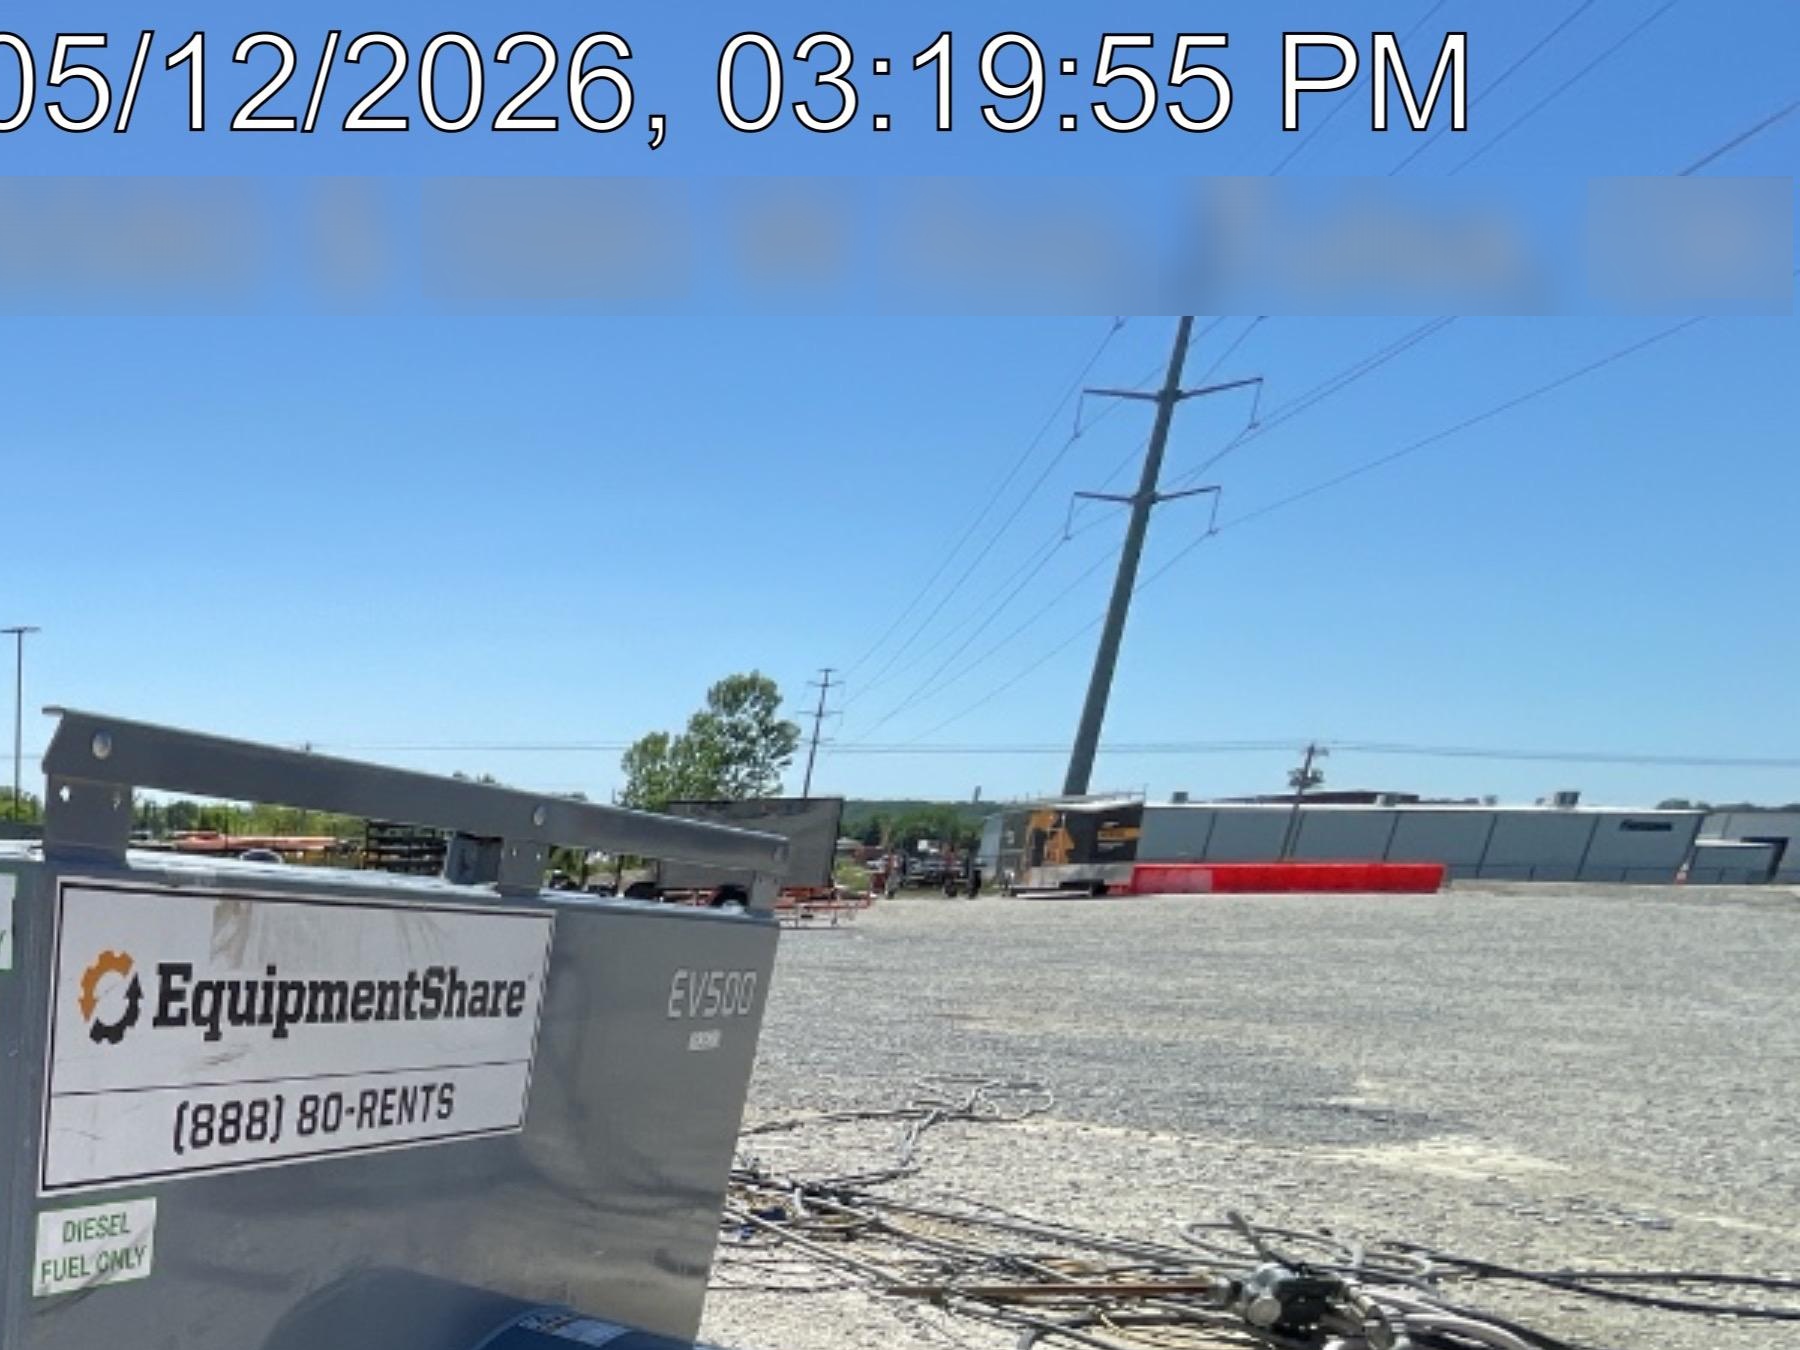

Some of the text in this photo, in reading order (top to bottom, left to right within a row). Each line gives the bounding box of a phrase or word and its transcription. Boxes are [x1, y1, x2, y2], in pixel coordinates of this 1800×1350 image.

[153, 962, 526, 1041] EquipmentShare
[667, 968, 757, 1018] EV500
[173, 1082, 455, 1154] (888) 80-RENTS
[63, 1211, 131, 1243] DIESEL
[41, 1245, 147, 1285] FUEL ONLY
